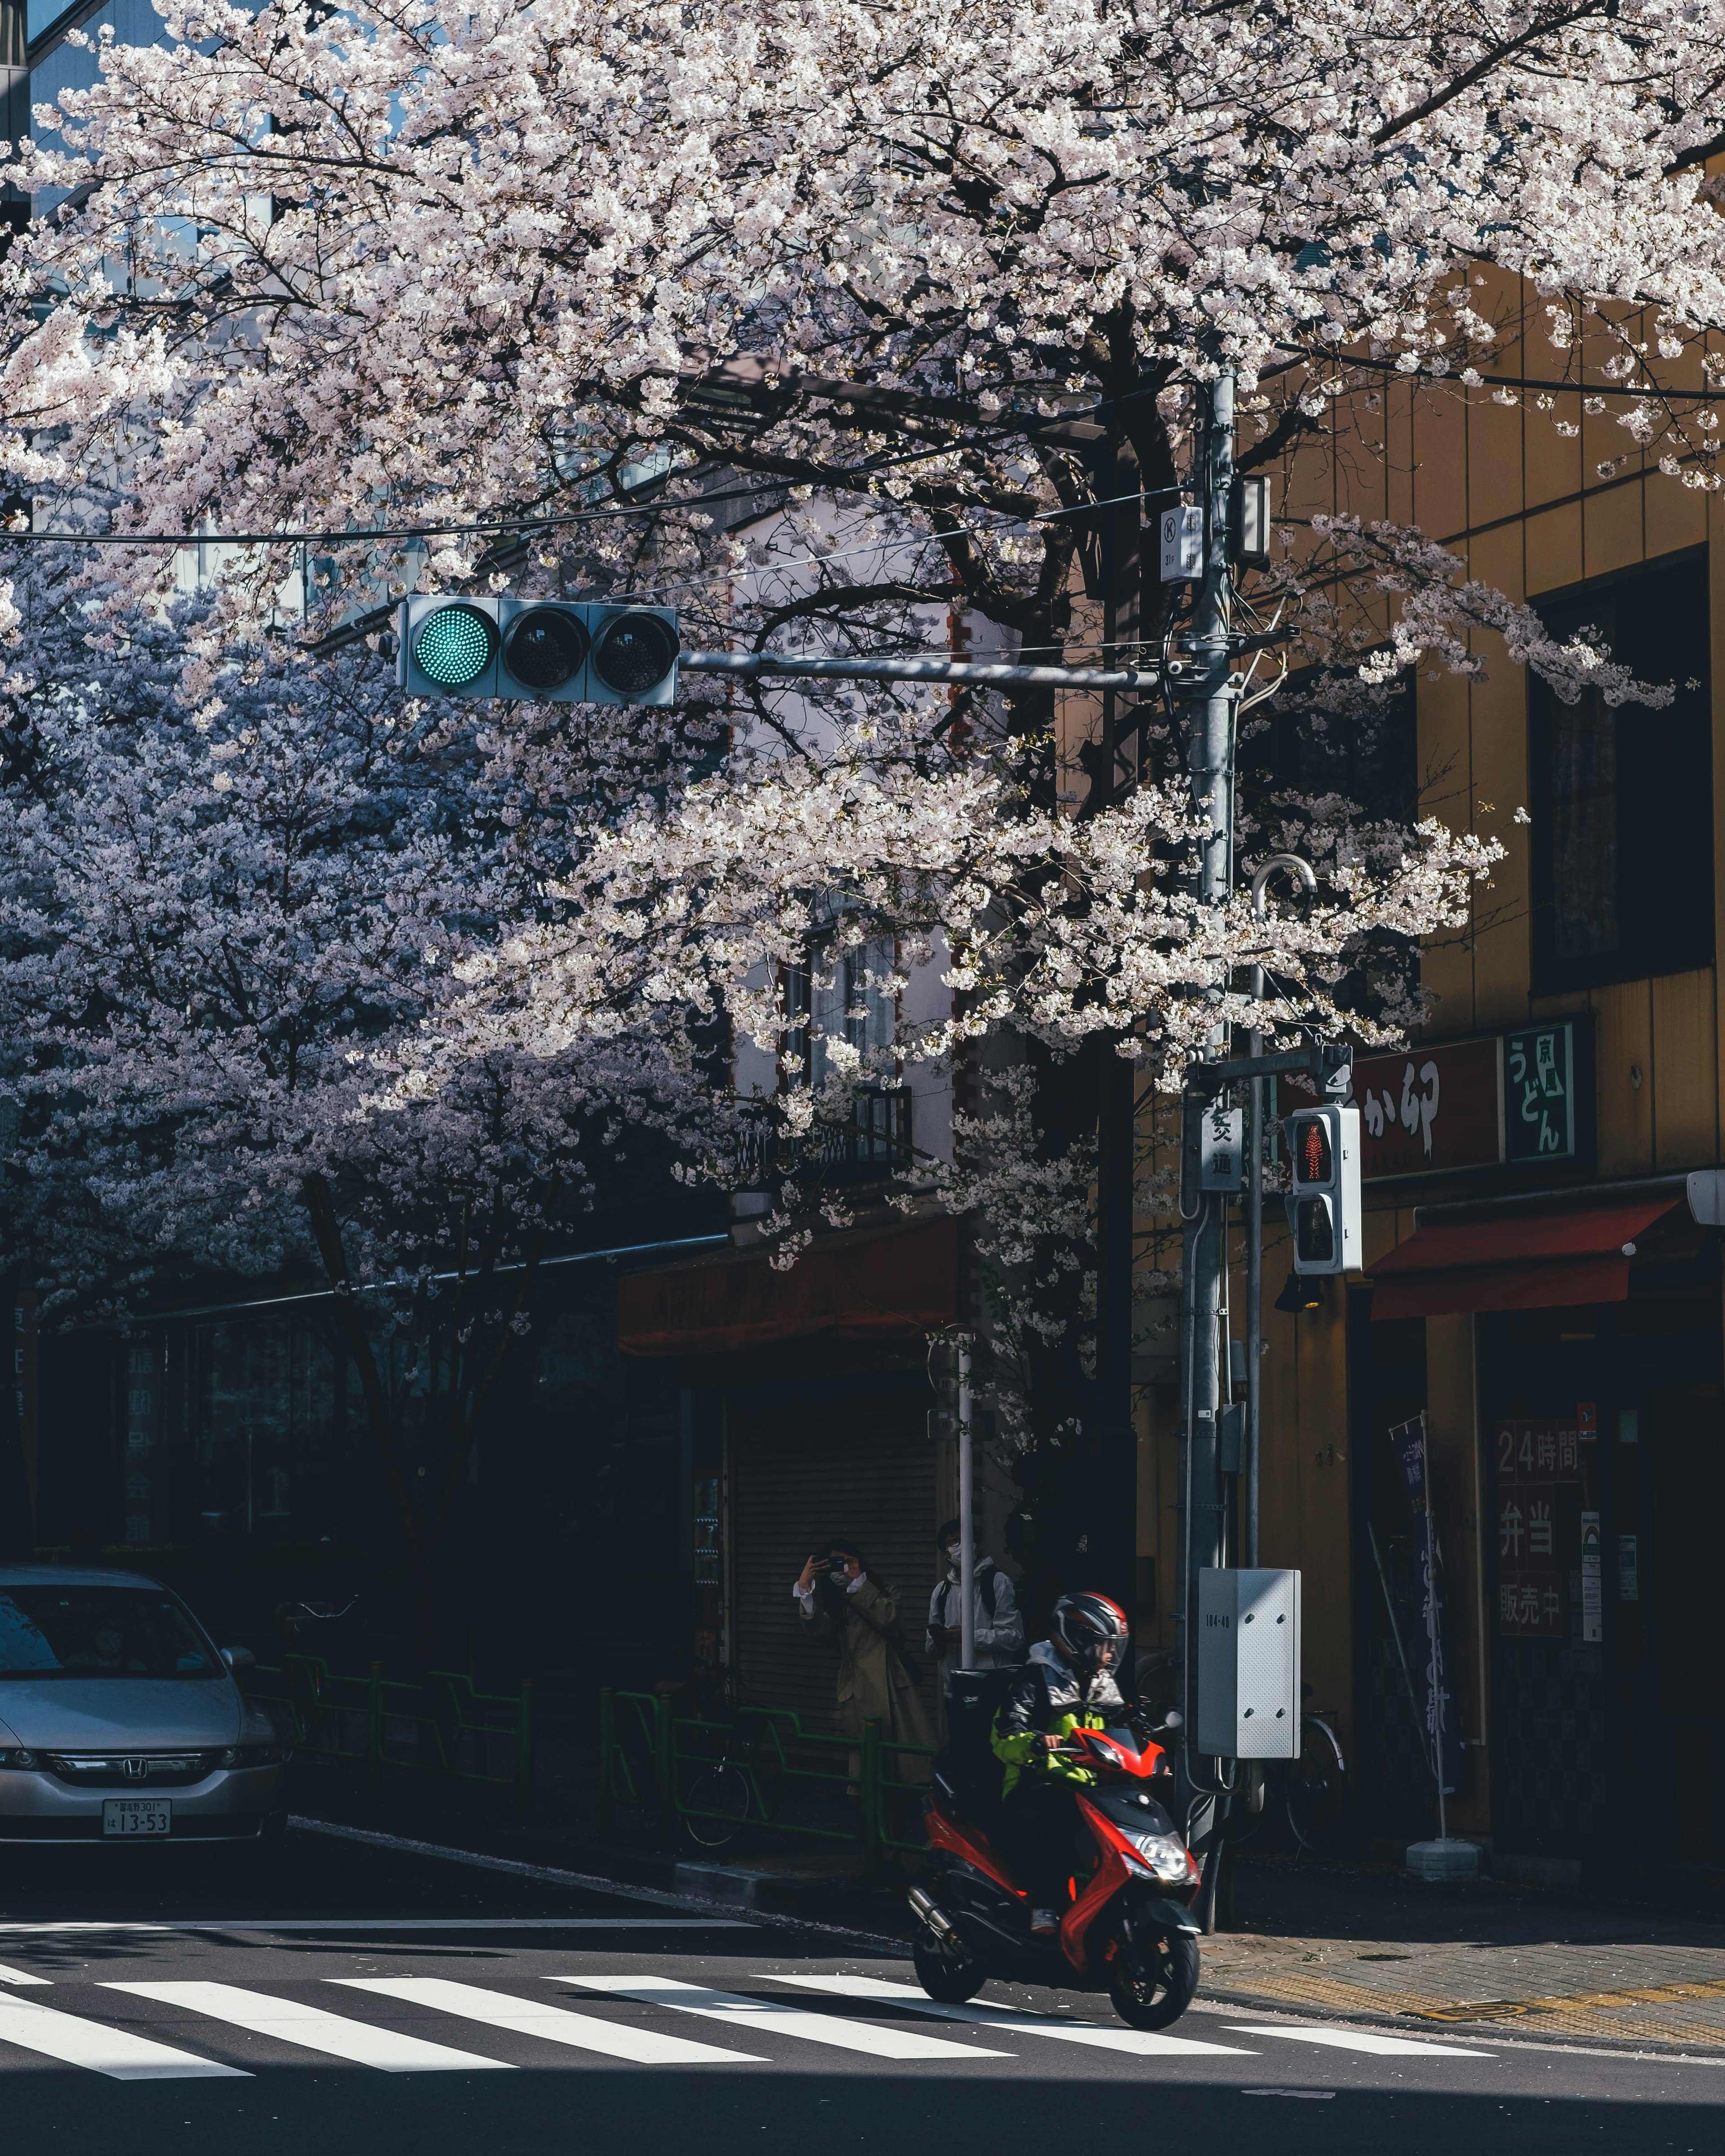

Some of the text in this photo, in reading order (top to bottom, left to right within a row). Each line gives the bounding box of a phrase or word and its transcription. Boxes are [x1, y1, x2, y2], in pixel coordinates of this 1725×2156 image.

[1509, 1041, 1559, 1152] うどん
[1207, 1122, 1232, 1175] 交通
[1498, 1430, 1577, 1472] 24時間
[1499, 1499, 1552, 1558] 弁当
[1206, 1614, 1230, 1629] 104-46
[1499, 1583, 1560, 1626] 販売中
[108, 1813, 167, 1832] は 13-53
